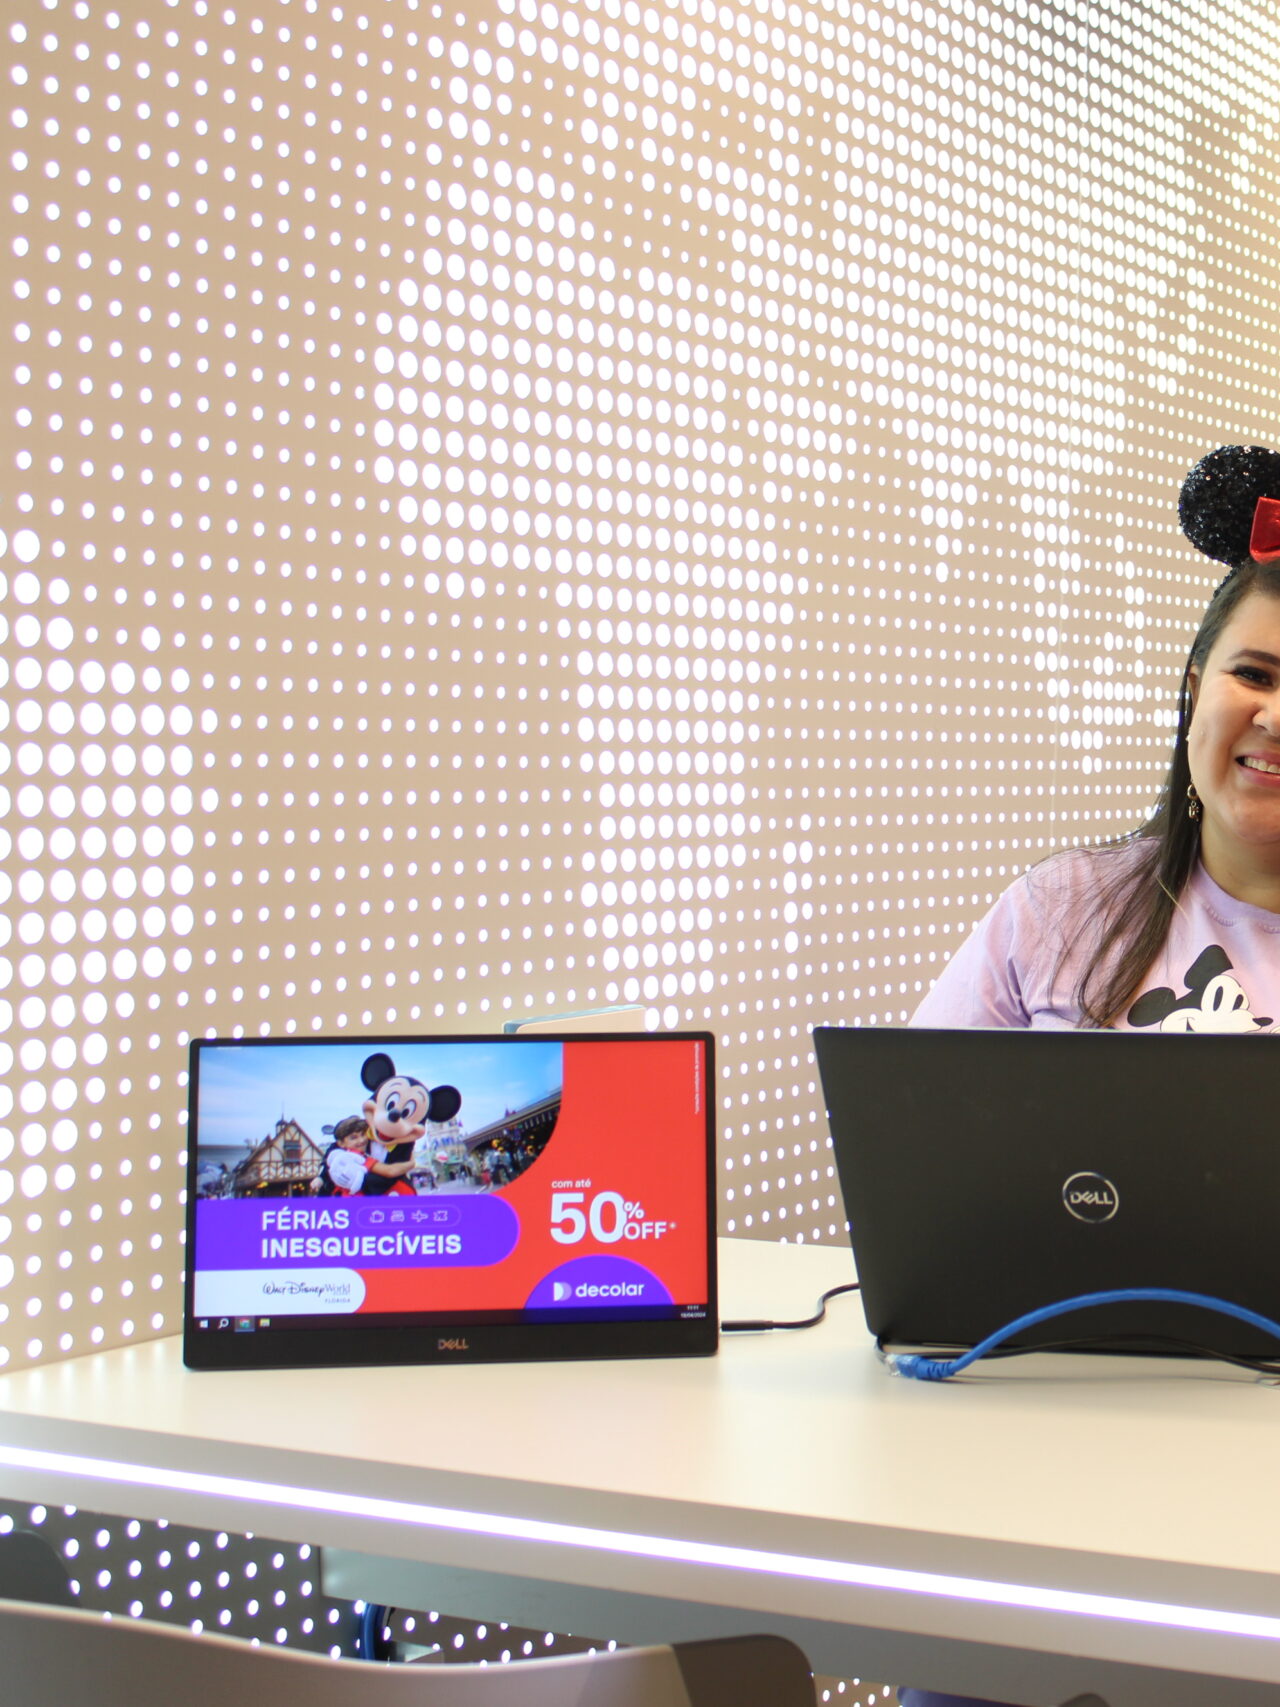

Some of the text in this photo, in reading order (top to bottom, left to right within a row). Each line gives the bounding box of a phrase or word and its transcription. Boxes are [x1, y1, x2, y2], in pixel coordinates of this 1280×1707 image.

[551, 1178, 592, 1188] com até
[1070, 1190, 1113, 1205] DELL
[262, 1206, 350, 1231] FÉRIAS
[261, 1231, 462, 1259] INESQUECÍVEIS
[575, 1282, 645, 1297] decolar
[437, 1338, 469, 1350] DELL
